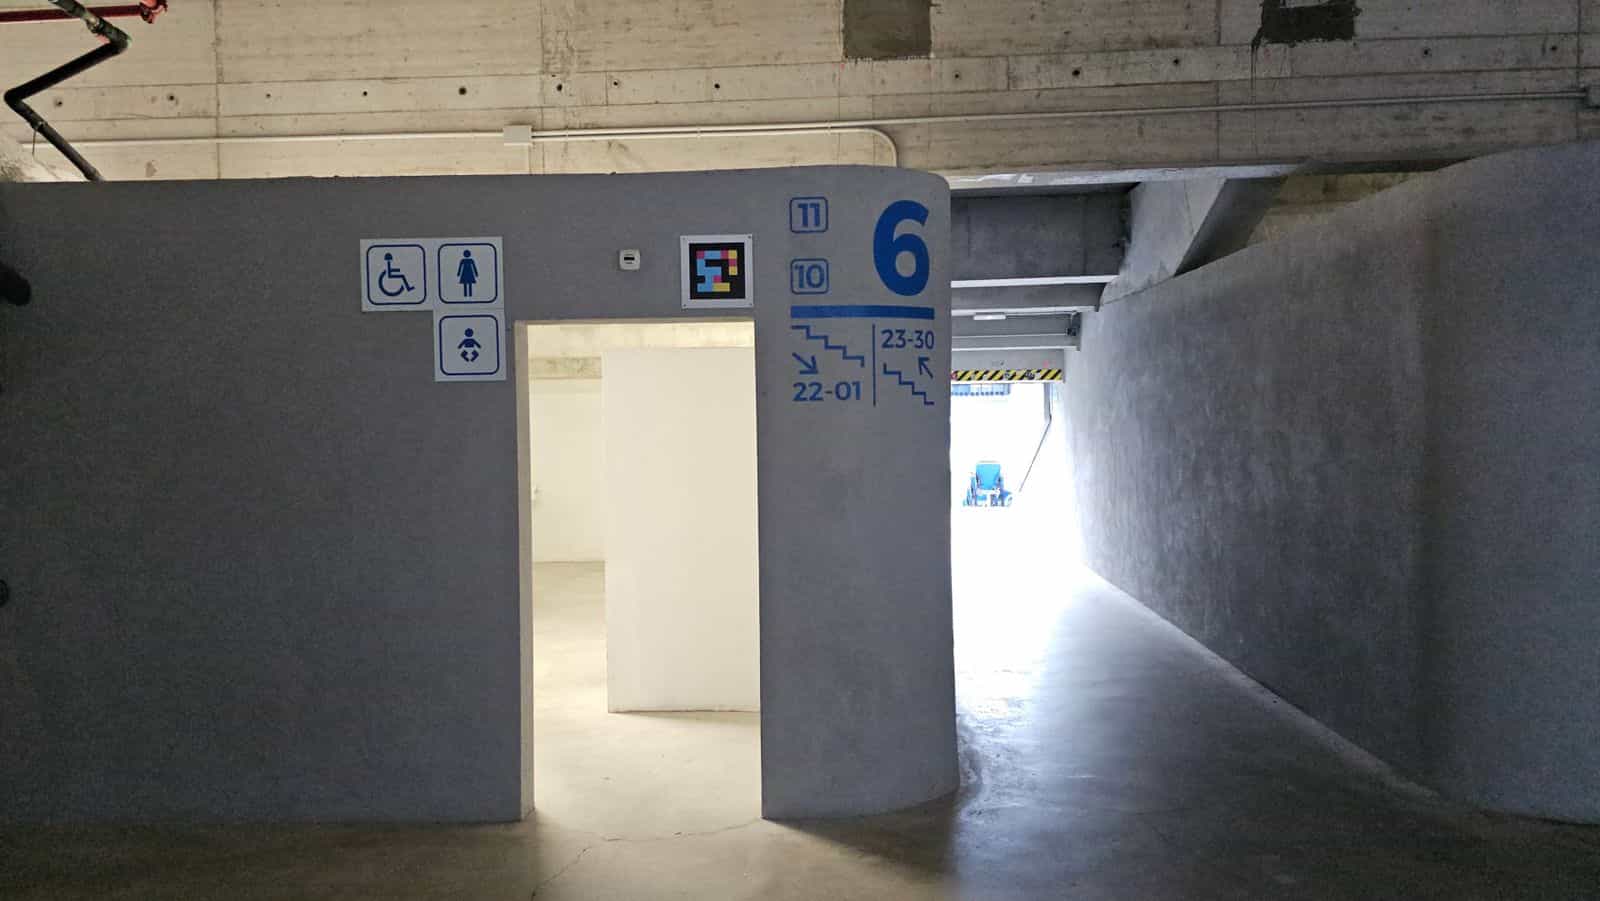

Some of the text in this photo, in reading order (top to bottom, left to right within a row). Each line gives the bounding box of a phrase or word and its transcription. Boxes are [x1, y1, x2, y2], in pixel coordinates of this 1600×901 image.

[798, 203, 821, 228] 11
[873, 200, 930, 296] 6
[794, 264, 825, 289] 10
[881, 329, 935, 350] 23-30
[792, 381, 861, 402] 22-01
